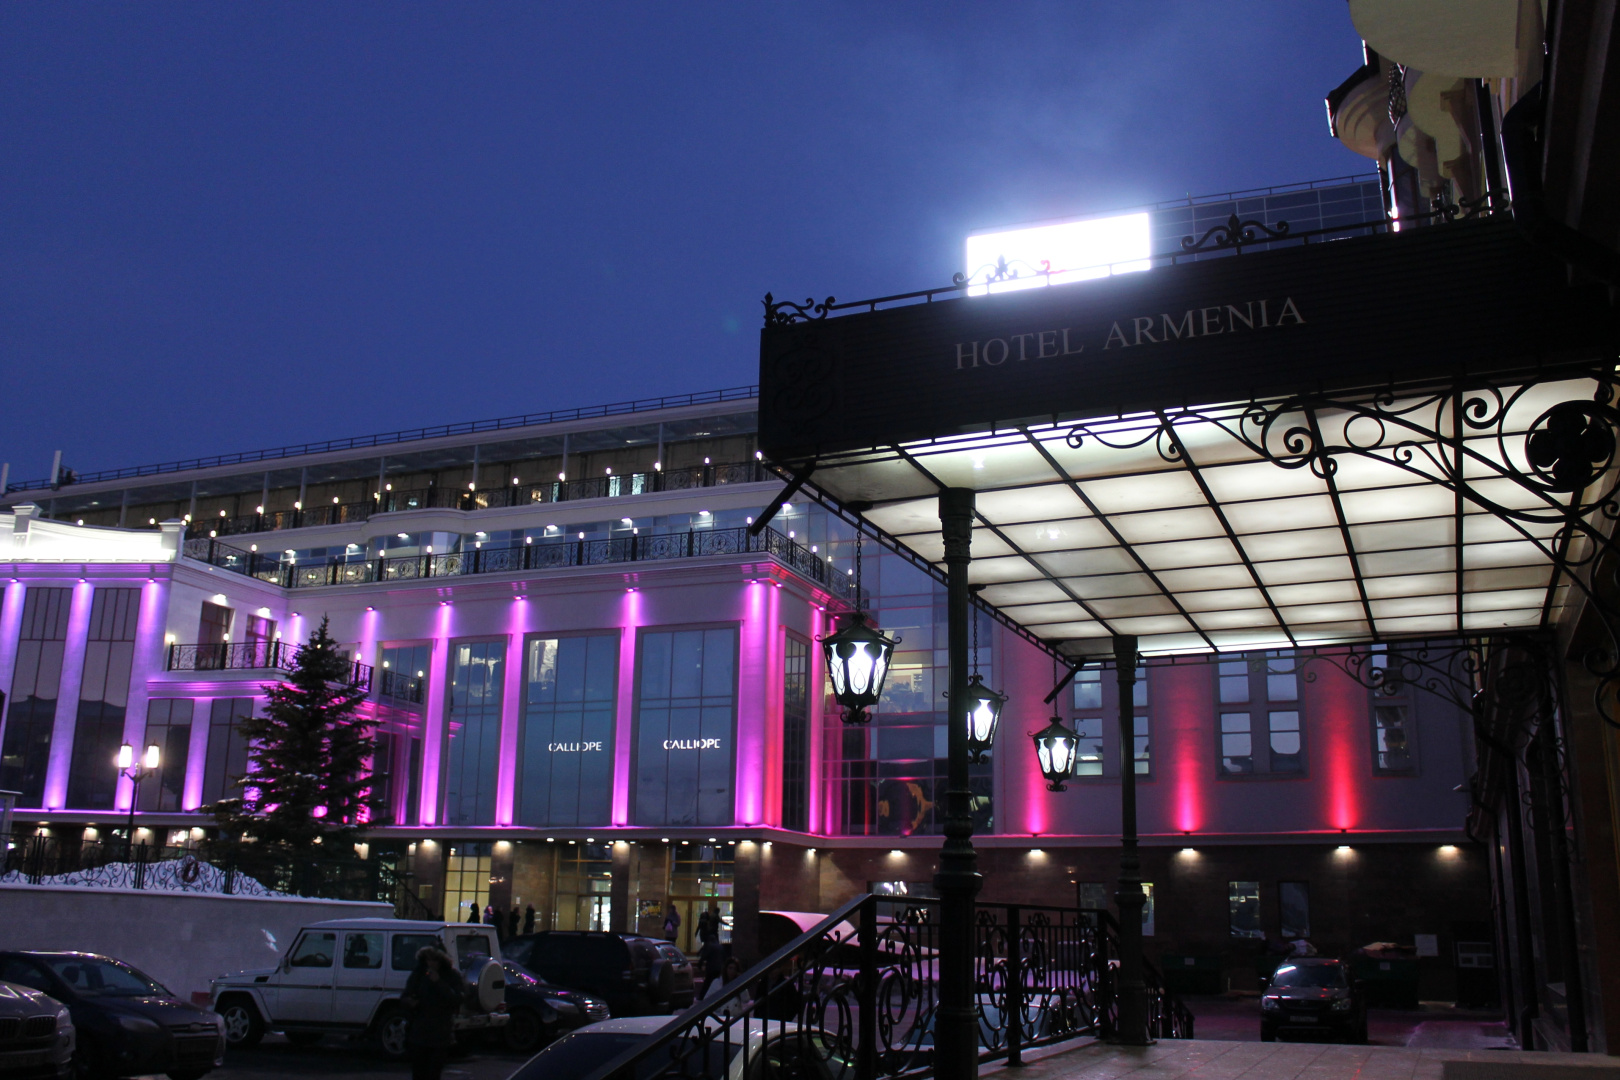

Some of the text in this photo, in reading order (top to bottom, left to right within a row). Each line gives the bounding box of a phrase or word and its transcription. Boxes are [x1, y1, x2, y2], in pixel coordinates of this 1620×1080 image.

[955, 297, 1306, 370] HOTEL ARMENIA
[548, 741, 602, 752] CALLIOPE
[663, 738, 721, 750] CALLIOPE
